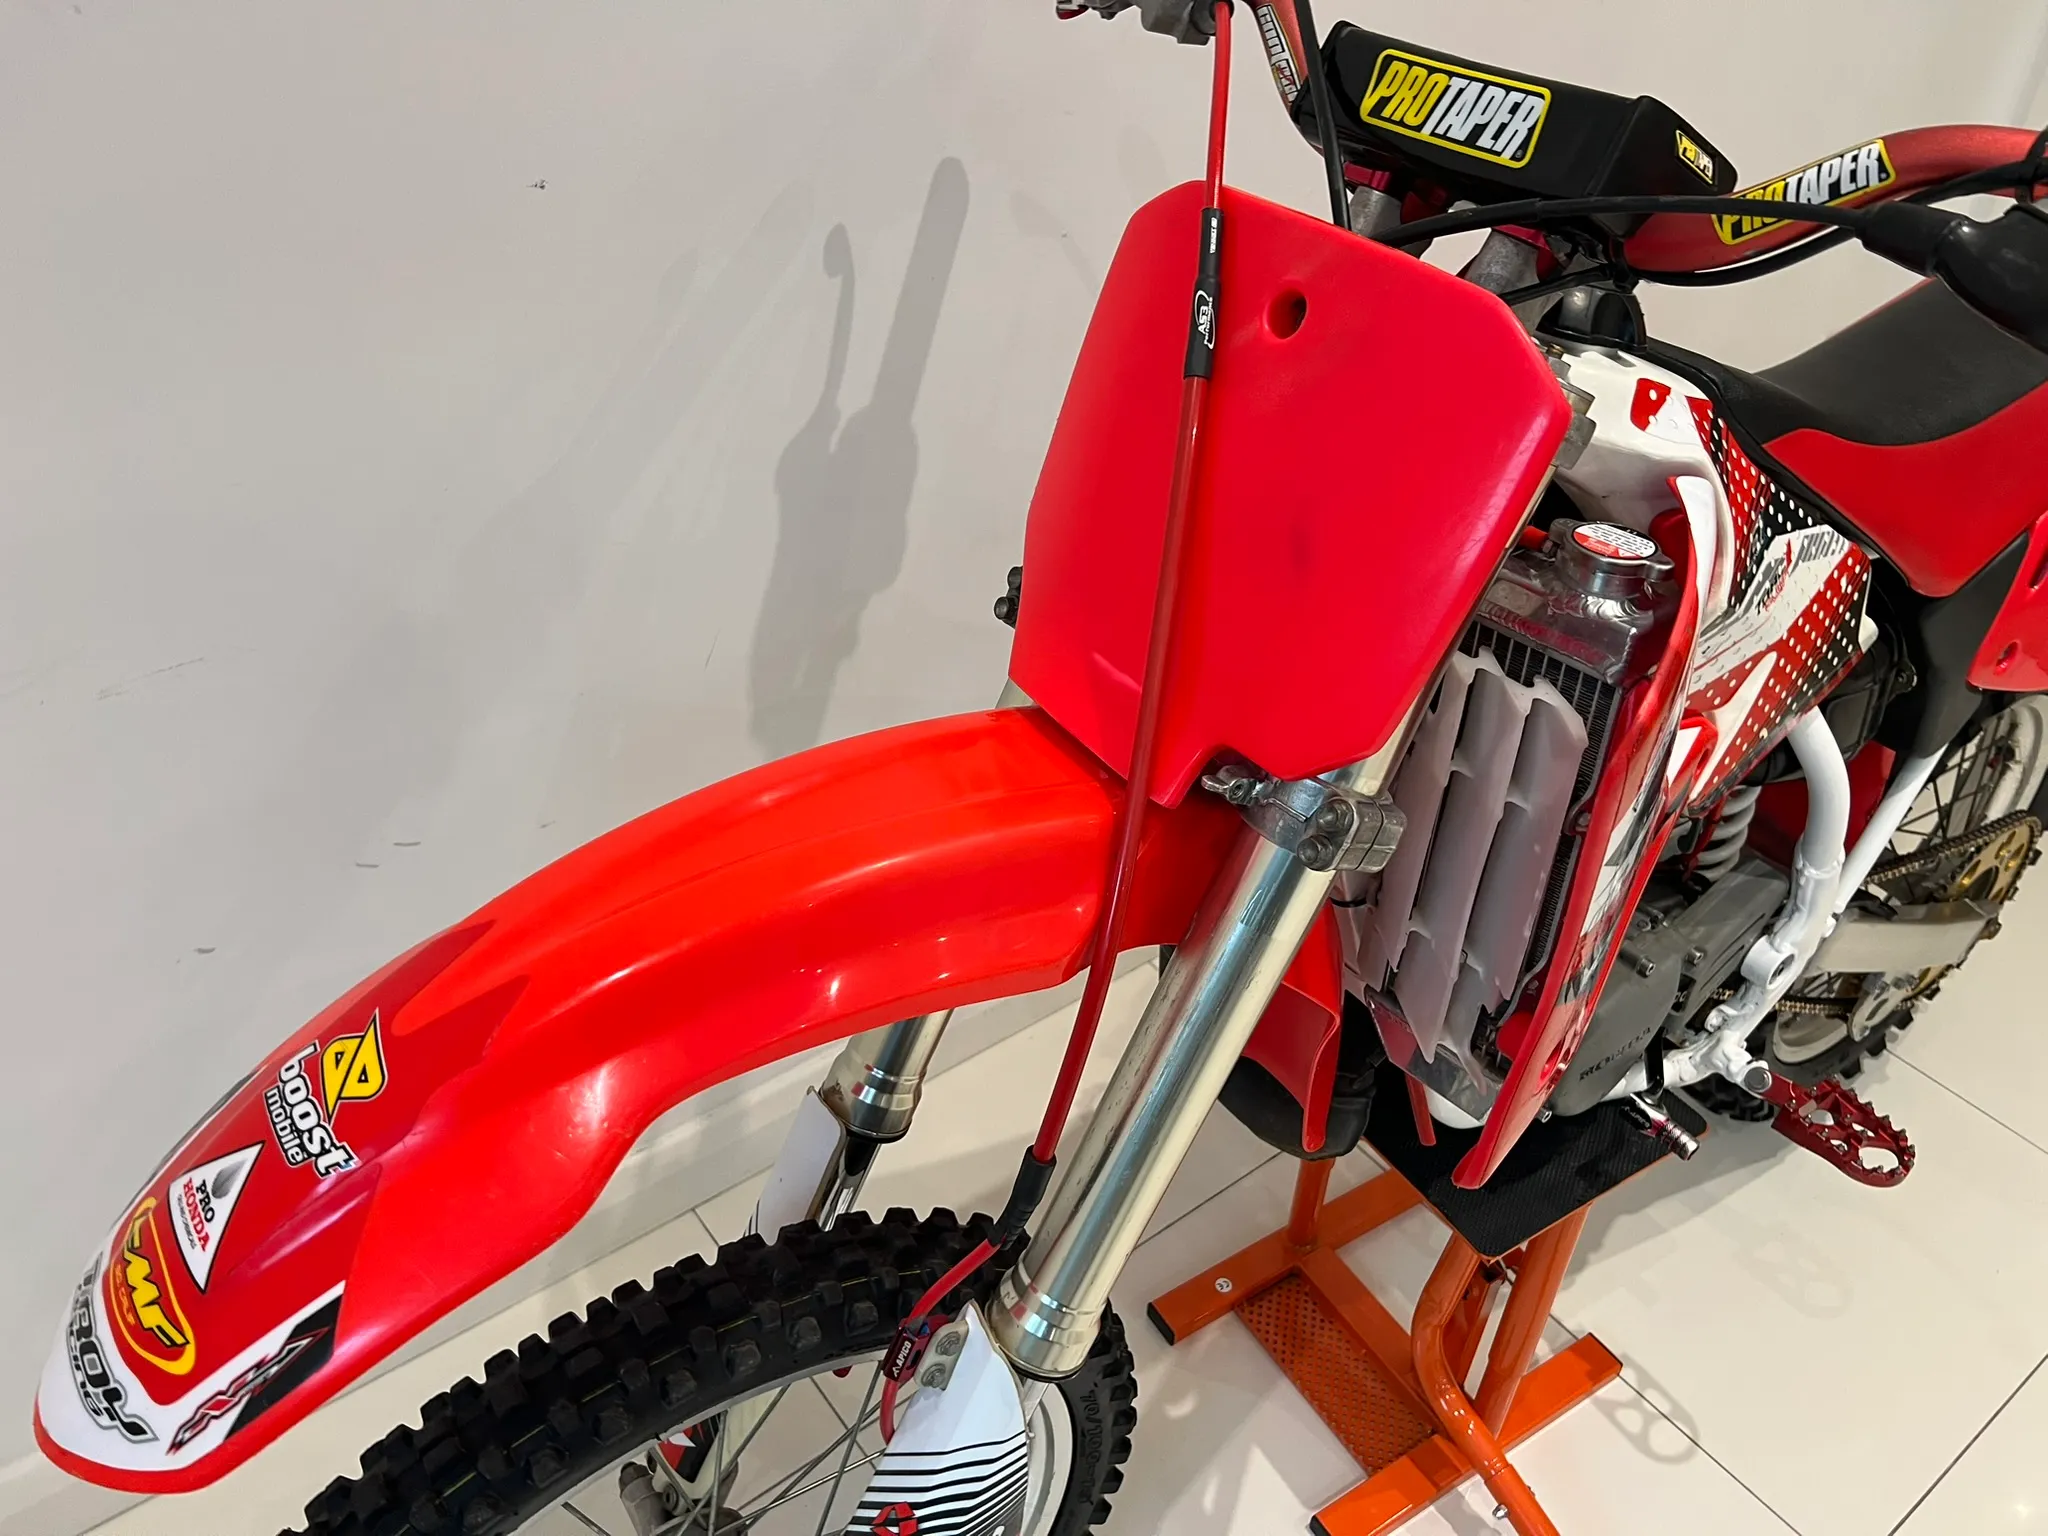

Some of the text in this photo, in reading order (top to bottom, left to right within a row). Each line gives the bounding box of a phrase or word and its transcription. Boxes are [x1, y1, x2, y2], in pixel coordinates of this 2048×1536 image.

[1375, 60, 1544, 158] PROTAPER
[1198, 305, 1209, 334] AS3
[265, 1088, 308, 1166] mobile
[279, 1043, 355, 1176] boost
[183, 1178, 211, 1251] HONDA
[195, 1180, 217, 1222] PRO
[122, 1214, 190, 1348] FMF
[896, 1340, 912, 1367] APICO
